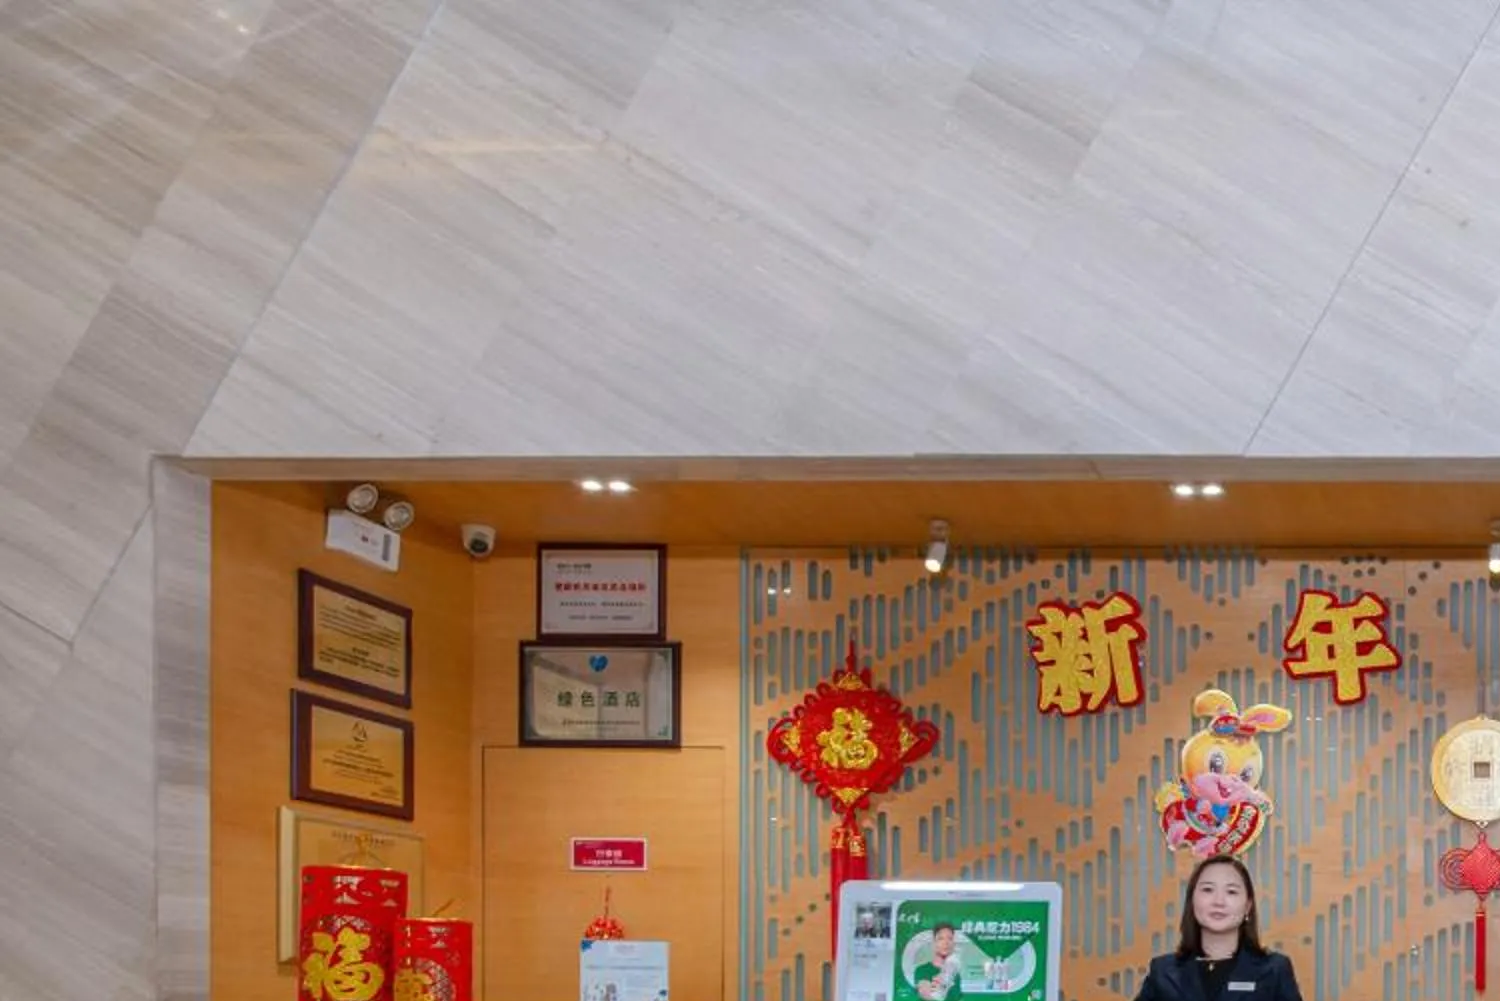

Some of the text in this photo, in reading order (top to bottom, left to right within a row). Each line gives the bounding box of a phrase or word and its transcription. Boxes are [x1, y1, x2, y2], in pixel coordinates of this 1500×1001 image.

[557, 690, 641, 708] 绿色酒店
[817, 706, 879, 770] 福
